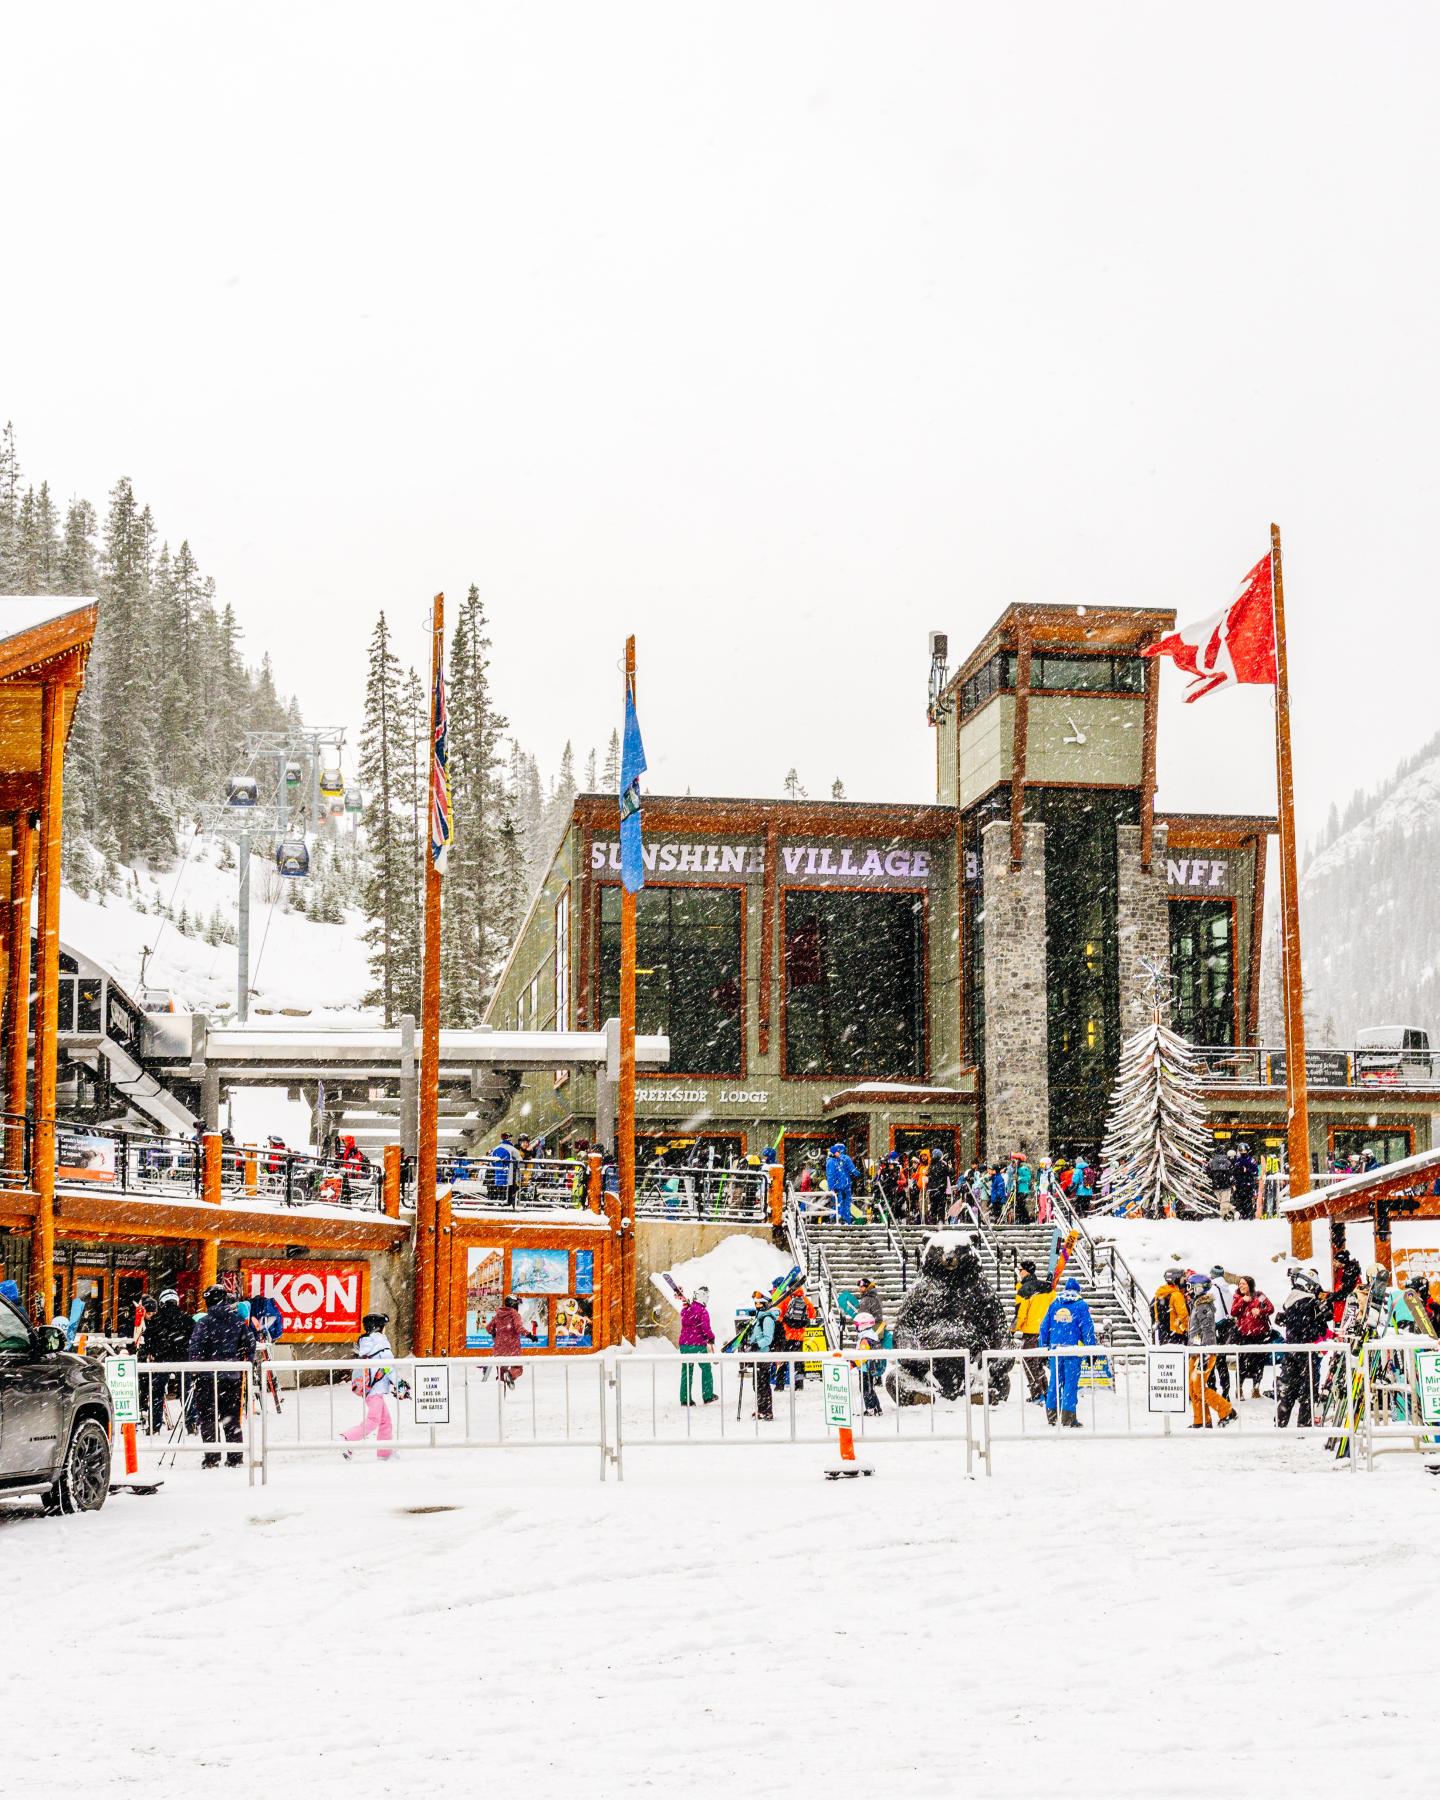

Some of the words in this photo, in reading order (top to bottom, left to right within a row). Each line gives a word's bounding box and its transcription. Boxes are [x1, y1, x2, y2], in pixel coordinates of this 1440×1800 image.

[592, 842, 765, 872] SUNSHINE
[782, 847, 930, 877] VILLAGE
[719, 1090, 768, 1103] LODGE
[251, 1273, 358, 1314] IKON
[282, 1317, 323, 1330] PASS
[117, 1363, 126, 1378] 5
[832, 1367, 841, 1382] 5
[110, 1381, 134, 1389] Minute
[826, 1384, 848, 1392] Minute
[827, 1392, 848, 1402] Parking
[115, 1400, 130, 1410] EXIT
[831, 1404, 845, 1415] EXIT
